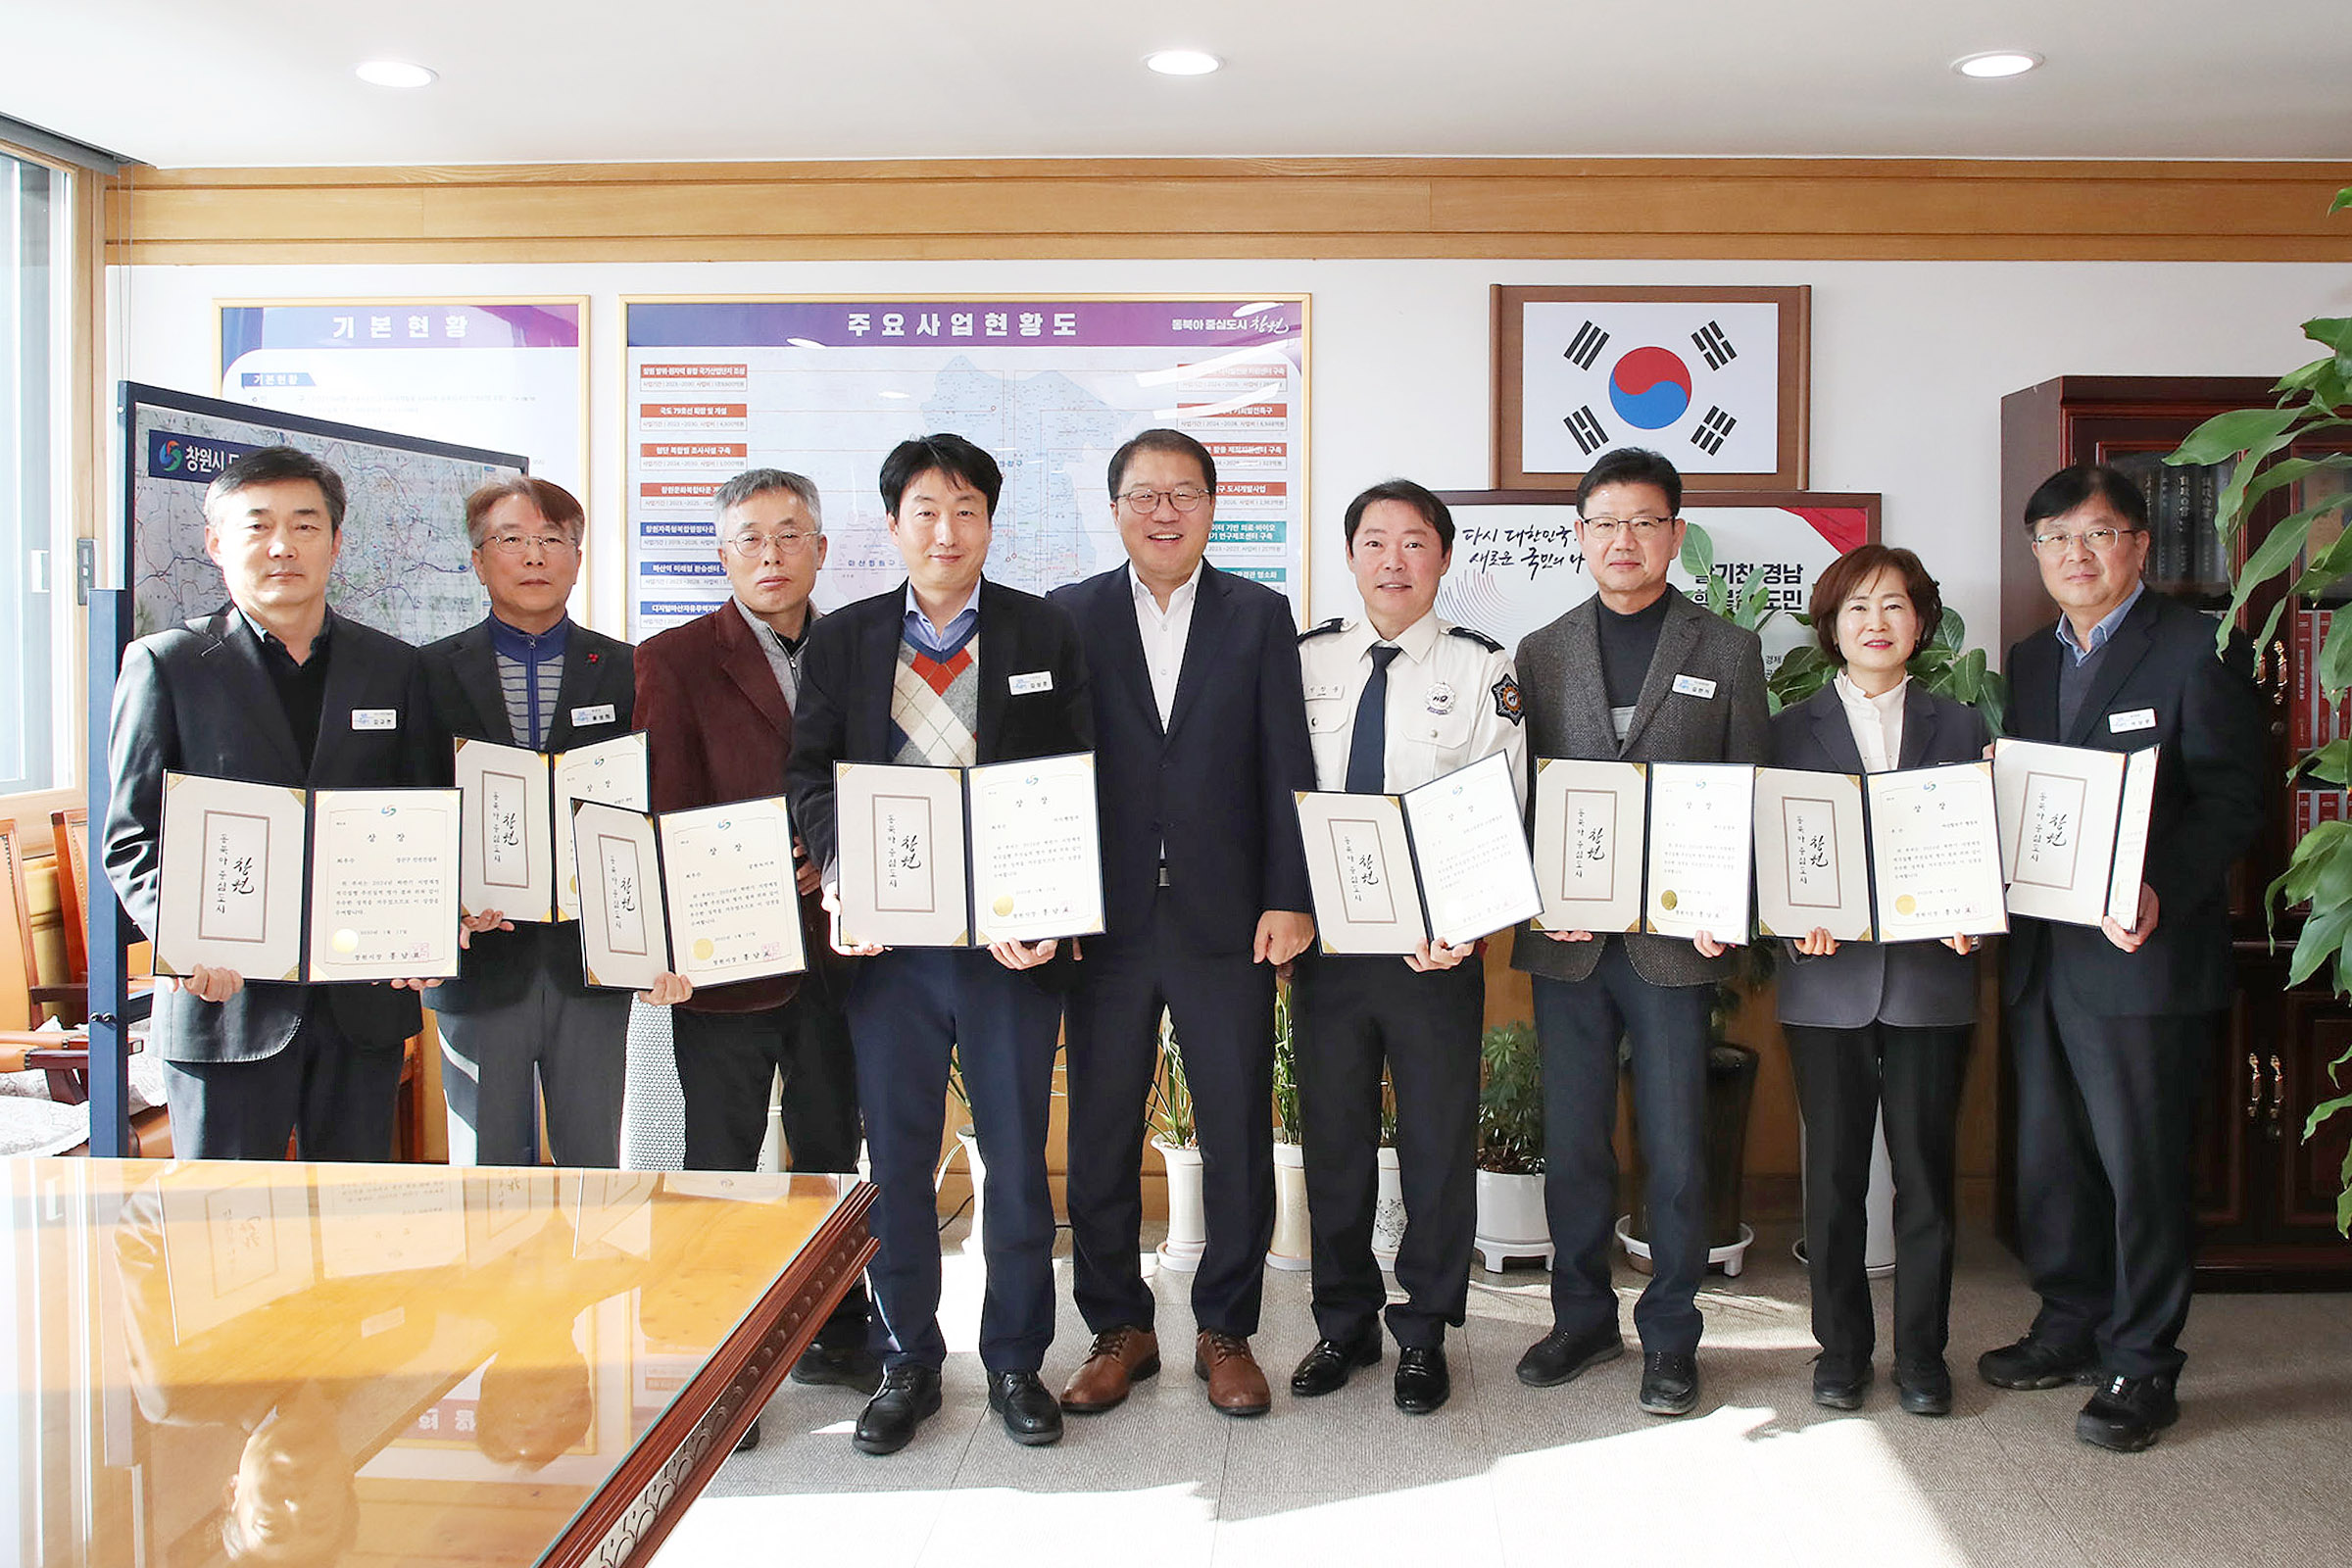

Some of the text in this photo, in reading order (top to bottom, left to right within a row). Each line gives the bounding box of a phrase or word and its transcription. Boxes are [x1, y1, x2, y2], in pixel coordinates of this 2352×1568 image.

[847, 312, 1078, 338] 주요사업현황도
[1171, 314, 1290, 334] 동북아 중심도시 창원
[184, 444, 225, 474] 창원시
[1462, 526, 1498, 545] 다시
[1469, 549, 1514, 574] 새로운
[1520, 547, 1565, 580] 국민의
[1763, 564, 1803, 585] 경남
[1763, 590, 1802, 611] 도민
[502, 811, 519, 847] 창원
[1587, 826, 1606, 861] 창원
[2045, 812, 2069, 848] 창원
[900, 834, 922, 870] 창원
[1809, 834, 1830, 869] 창원
[230, 857, 255, 896] 창원
[1358, 854, 1380, 886] 창원
[619, 876, 637, 912] 창원
